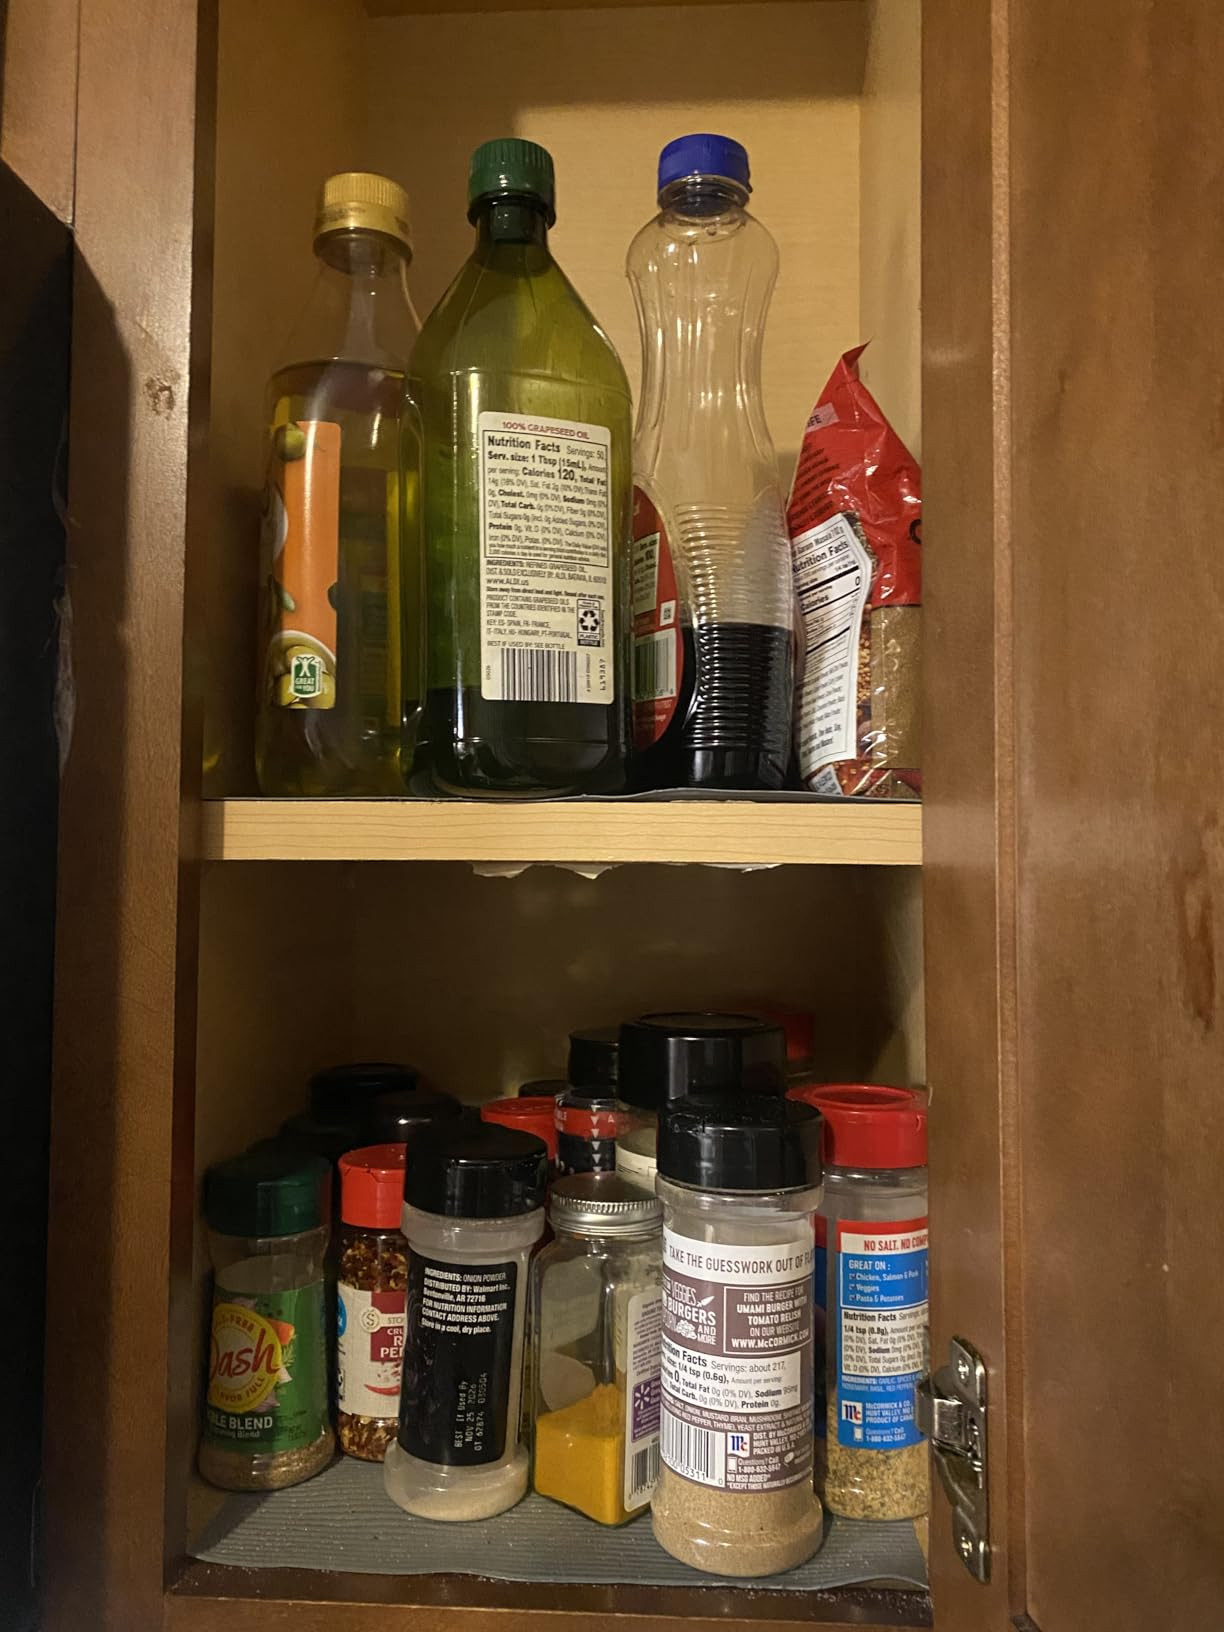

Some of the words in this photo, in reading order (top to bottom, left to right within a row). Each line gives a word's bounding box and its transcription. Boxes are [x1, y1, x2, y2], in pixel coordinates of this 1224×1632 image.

[502, 422, 526, 431] 100%
[528, 424, 575, 437] GRAPESEED
[577, 431, 590, 440] OIL
[488, 436, 531, 449] Nutrition
[535, 440, 561, 453] Facts
[488, 451, 509, 461] Serv.
[511, 453, 529, 463] size:
[532, 455, 535, 463] 1
[538, 455, 557, 467] Tbsp
[522, 467, 555, 479] Calories
[828, 541, 849, 556] Facts
[864, 1240, 876, 1251] NO
[878, 1240, 899, 1251] SALT.
[901, 1239, 911, 1250] NO
[669, 1245, 685, 1264] TAKE
[686, 1253, 703, 1268] THE
[706, 1257, 773, 1274] GUESSWORK
[776, 1257, 793, 1272] OUT
[795, 1256, 803, 1268] OF
[848, 1260, 872, 1270] GREAT
[425, 1267, 463, 1282] INGREDIENTS:
[463, 1274, 482, 1282] ONION
[483, 1272, 506, 1282] POWDER
[424, 1278, 461, 1292] DISTRIBUTED
[473, 1284, 499, 1293] Walmart
[856, 1283, 880, 1293] Veggies
[672, 1282, 696, 1306] VEGGIES
[744, 1293, 760, 1303] FIND
[762, 1292, 774, 1301] THE
[423, 1298, 433, 1307] FOR
[434, 1301, 465, 1313] NUTRITION
[467, 1302, 508, 1313] INFORMATION
[668, 1297, 716, 1326] BURGERS
[737, 1303, 765, 1314] UMAMI
[766, 1301, 793, 1313] BURGER
[422, 1307, 447, 1321] CONTACT
[447, 1313, 477, 1323] ADDRESS
[478, 1313, 500, 1322] ABOVE.
[748, 1315, 779, 1326] TOMATO
[780, 1310, 801, 1323] RELISH
[843, 1311, 876, 1322] Nutrition
[878, 1314, 897, 1322] Facts
[421, 1318, 435, 1328] Store
[435, 1321, 441, 1330] in
[462, 1325, 473, 1335] dry
[473, 1326, 492, 1334] place.
[697, 1325, 716, 1336] AND
[749, 1327, 760, 1337] ON
[762, 1326, 775, 1337] OUR
[856, 1327, 866, 1335] tsp
[697, 1333, 716, 1345] MORE
[682, 1351, 707, 1367] Facts
[711, 1361, 747, 1374] Servings:
[750, 1362, 771, 1373] about
[689, 1368, 701, 1378] tsp
[682, 1378, 697, 1390] Total
[699, 1384, 710, 1394] Fat
[755, 1388, 782, 1398] Sodium
[682, 1388, 698, 1401] Carb.
[741, 1400, 769, 1409] Protein
[229, 1416, 273, 1430] BLEND
[466, 1411, 475, 1422] 25
[702, 1412, 729, 1422] MUSTARD
[454, 1431, 464, 1448] BEST
[465, 1425, 474, 1442] NOV
[727, 1474, 736, 1482] NO
